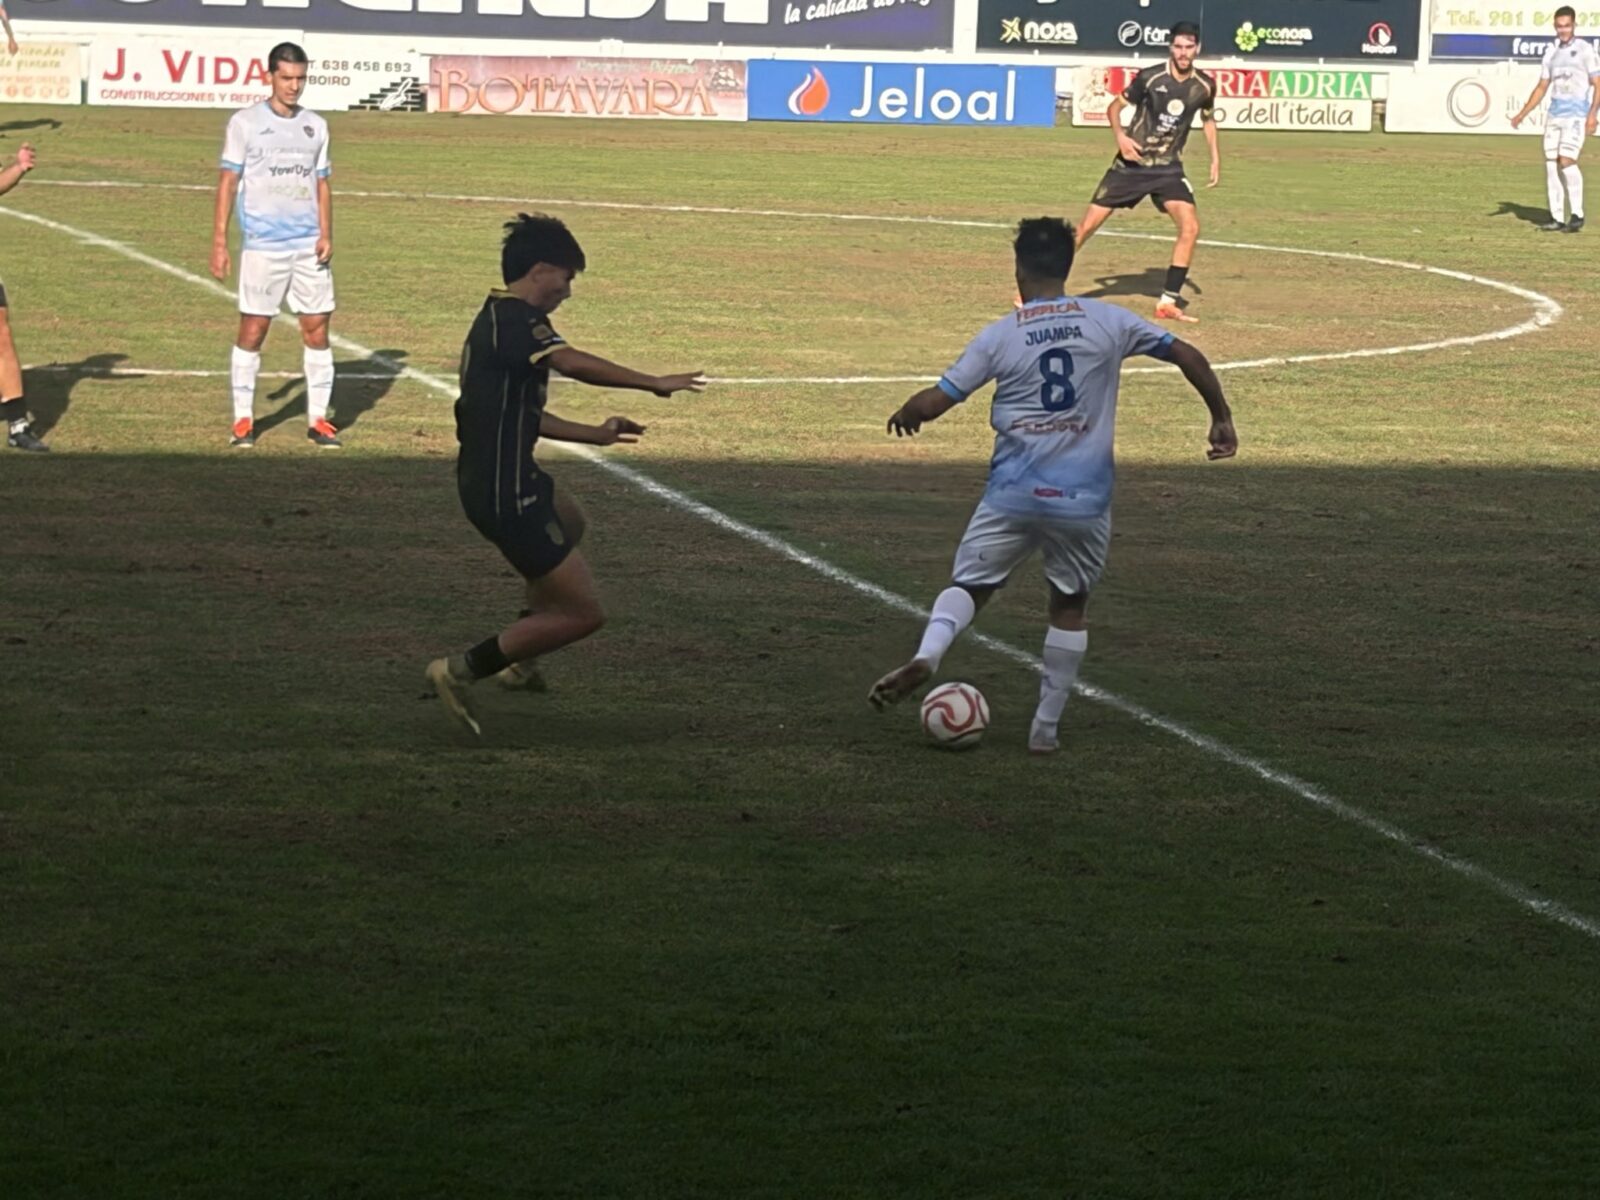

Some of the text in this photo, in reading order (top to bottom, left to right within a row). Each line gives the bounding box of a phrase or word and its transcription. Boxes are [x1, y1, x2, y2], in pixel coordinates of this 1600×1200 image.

[784, 3, 801, 25] la
[1023, 21, 1078, 41] nosa
[1257, 28, 1313, 41] econosa
[102, 48, 142, 82] J.
[322, 60, 349, 71] 638
[353, 61, 380, 72] 458
[384, 62, 412, 73] 693
[308, 75, 351, 86] BOIRO
[1270, 71, 1370, 98] ADRIA
[100, 88, 215, 103] CONSTRUCCIONES
[219, 92, 228, 103] Y
[434, 67, 718, 116] BOTAVARA
[849, 65, 1016, 121] Jeloal
[1025, 325, 1083, 346] JUAMPA
[1039, 347, 1075, 412] 8
